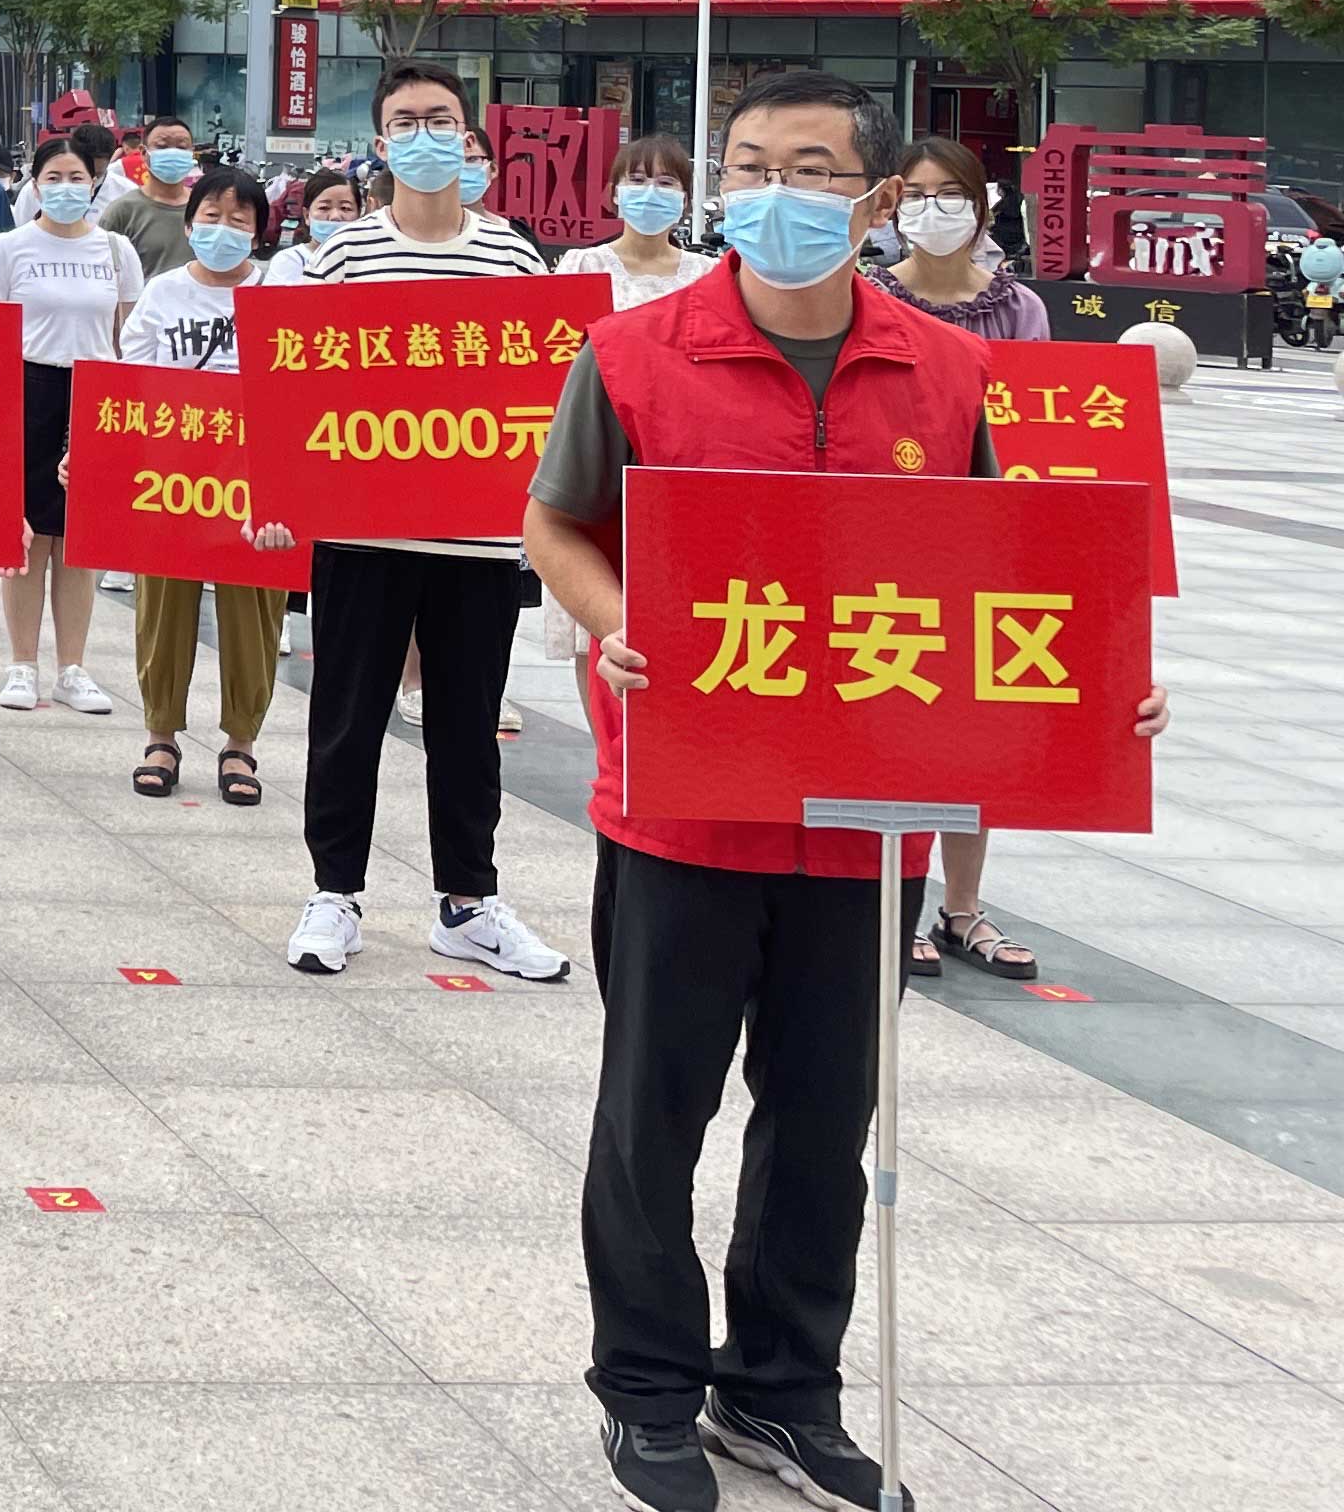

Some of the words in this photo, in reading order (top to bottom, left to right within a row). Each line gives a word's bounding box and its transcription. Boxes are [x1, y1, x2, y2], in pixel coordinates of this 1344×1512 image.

[1043, 149, 1065, 275] CHENGXIN
[268, 318, 584, 372] 龙安区慈善总会
[95, 396, 246, 446] 东风乡郭李
[306, 406, 554, 461] 40000元
[132, 470, 251, 521] 2000
[691, 578, 1081, 706] 龙安区
